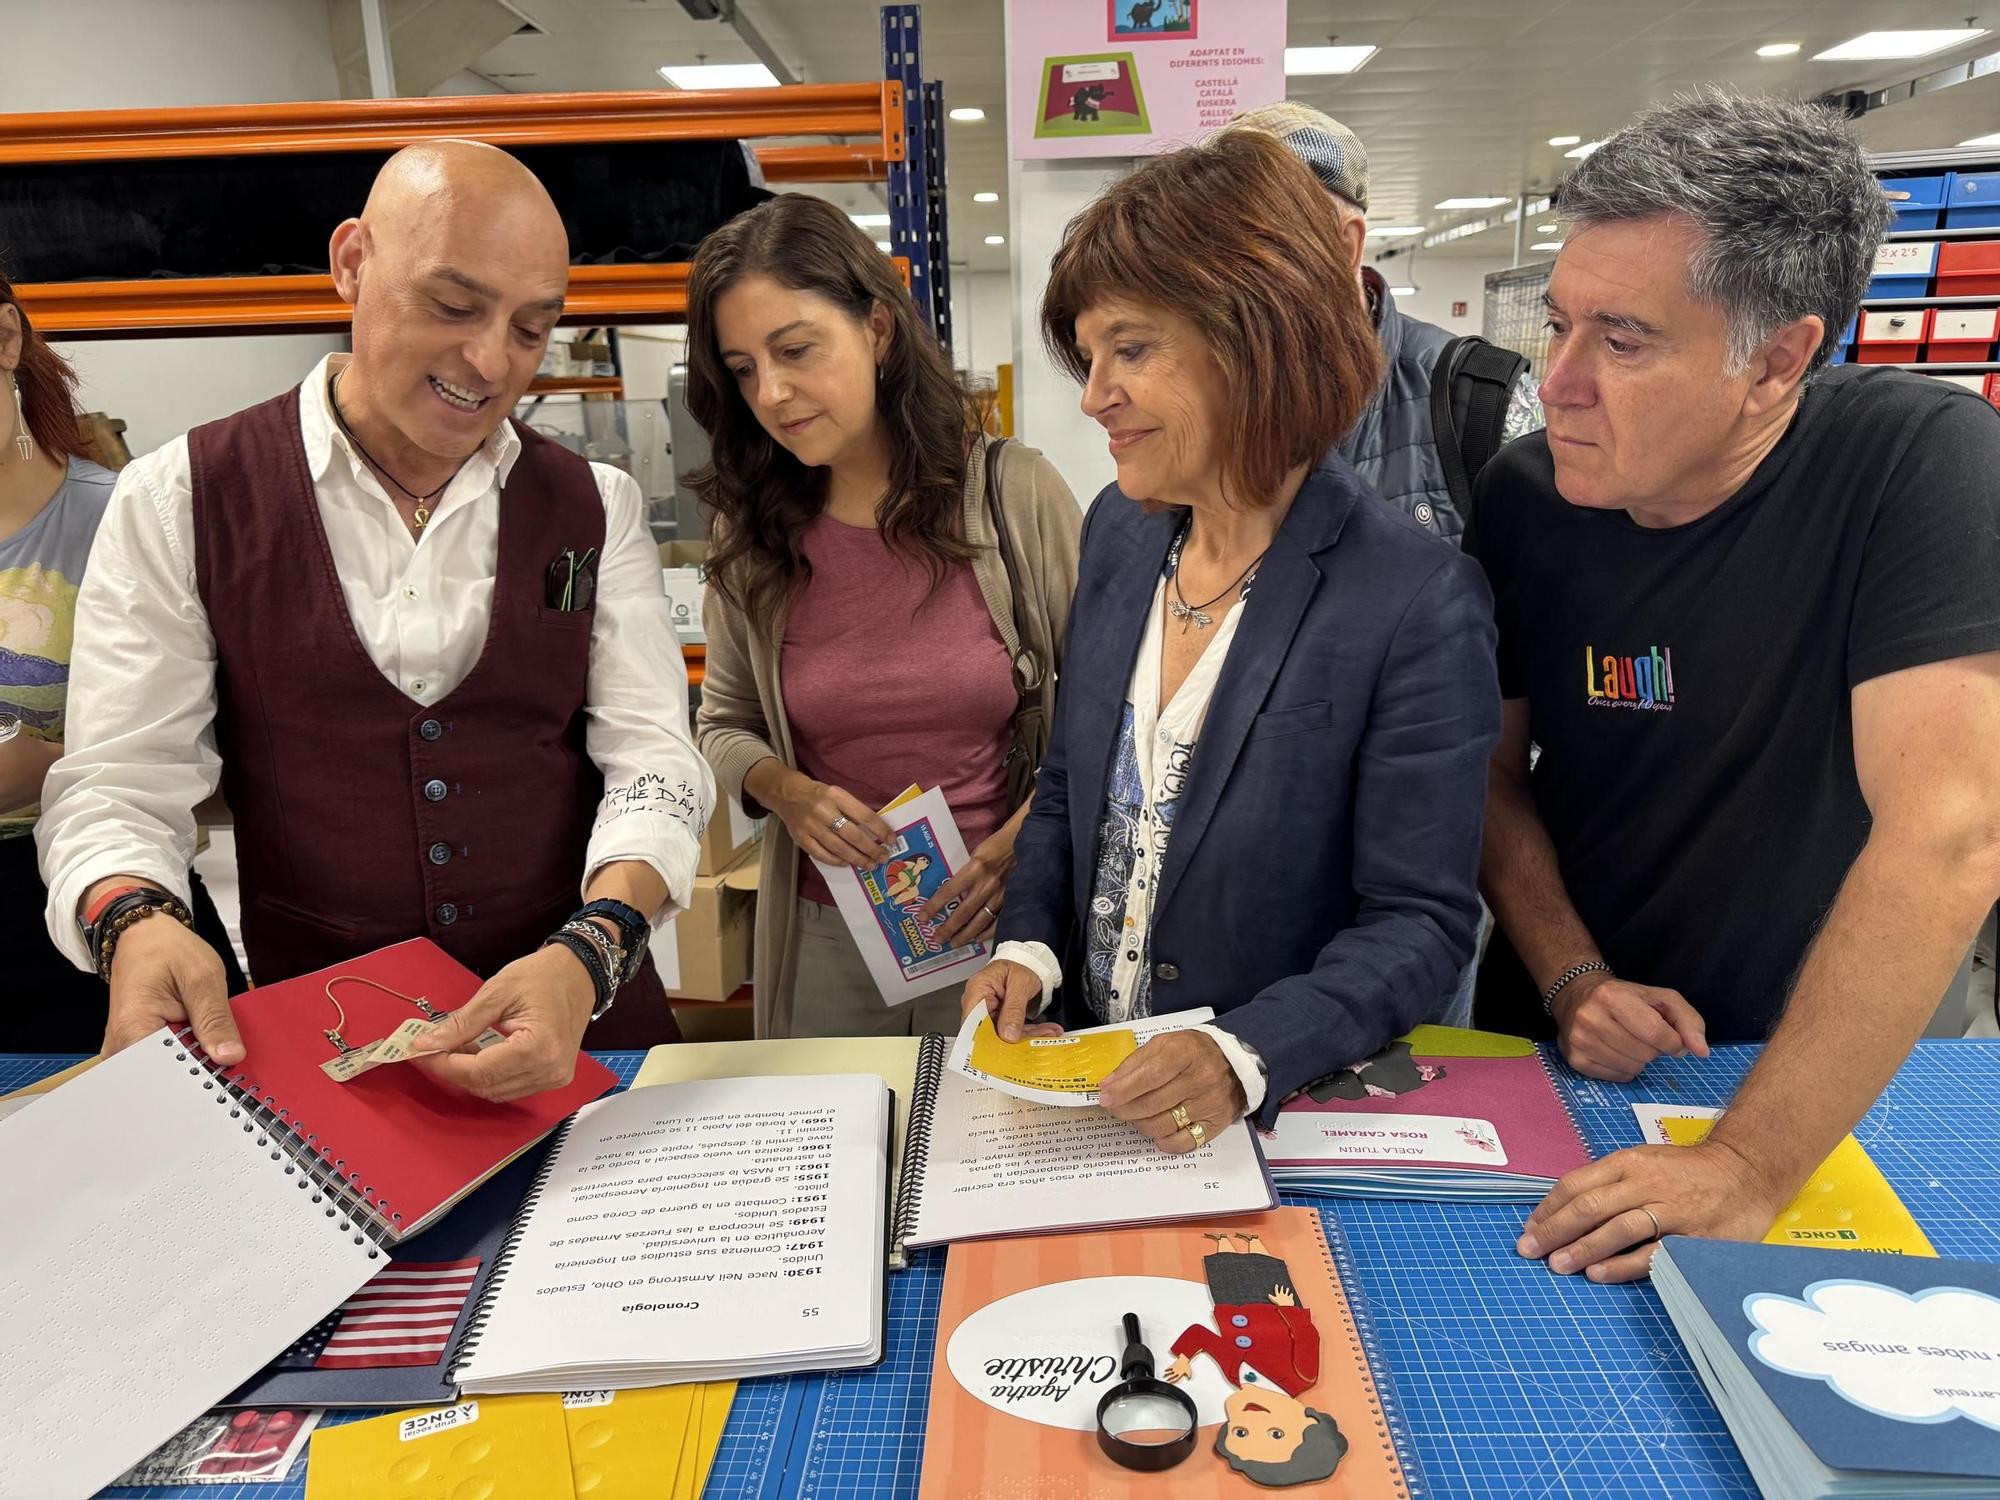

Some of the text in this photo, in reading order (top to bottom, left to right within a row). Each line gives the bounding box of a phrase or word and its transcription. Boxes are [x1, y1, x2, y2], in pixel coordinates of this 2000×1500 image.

[1189, 47, 1245, 57] ADAPTAT EN
[1169, 59, 1220, 68] DIFERENTS
[1196, 99, 1236, 107] EUSKERA
[1200, 109, 1233, 117] GALLEG
[1586, 646, 1675, 705] Laugh!
[866, 880, 882, 902] ONCE
[697, 1113, 724, 1121] pisar
[788, 1108, 822, 1116] primer
[652, 1118, 681, 1126] Luna.
[702, 1123, 732, 1131] Apolo
[616, 1128, 665, 1140] convierte
[1320, 1130, 1386, 1138] CARAMEL
[698, 1141, 746, 1150] después,
[766, 1136, 803, 1145] Gemini
[638, 1147, 658, 1155] con
[661, 1144, 693, 1152] repite
[1339, 1145, 1424, 1155] ADELA TURIN
[595, 1152, 621, 1161] nave
[655, 1153, 699, 1163] espacial
[752, 1154, 814, 1163] astronauta.
[969, 1149, 1141, 1172] soledad, fuerza ganas
[1142, 1155, 1178, 1164] diario.
[608, 1159, 640, 1168] bordo
[1084, 1160, 1123, 1169] hacerlo
[667, 1171, 724, 1180] selecciona
[743, 1167, 773, 1175] NASA
[1006, 1164, 1078, 1177] desaparecían
[1096, 1166, 1152, 1177] agradable
[732, 1176, 771, 1186] gradúa
[794, 1173, 829, 1181] 1955:
[571, 1180, 634, 1192] convertirse
[652, 1182, 708, 1193] Ingeniería
[795, 1182, 828, 1191] piloto.
[953, 1183, 994, 1193] escribir
[572, 1188, 648, 1202] Aeroespacial.
[792, 1194, 827, 1202] 1951:
[735, 1198, 786, 1206] Combate
[660, 1203, 698, 1212] guerra
[734, 1205, 826, 1218] Estados Unidos.
[567, 1214, 598, 1223] como
[789, 1216, 825, 1226] 1949:
[709, 1222, 764, 1230] incorpora
[626, 1229, 672, 1238] Fuerzas
[754, 1228, 825, 1240] Aeronáutica
[1791, 1231, 1837, 1239] ONCE
[568, 1234, 622, 1244] Armadas
[643, 1237, 715, 1249] universidad.
[722, 1245, 780, 1254] Comienza
[786, 1241, 824, 1251] 1947:
[641, 1250, 692, 1260] estudios
[778, 1254, 823, 1264] Unidos.
[555, 1256, 617, 1270] Ingeniería
[784, 1266, 822, 1277] 1930:
[648, 1274, 715, 1284] Armstrong
[719, 1273, 742, 1281] Neil
[536, 1284, 585, 1295] Estados
[592, 1281, 623, 1289] Ohio,
[622, 1302, 699, 1314] Cronología
[802, 1307, 819, 1317] 55
[1822, 1340, 1992, 1361] nubes amigas
[983, 1355, 1117, 1384] Christie
[989, 1377, 1071, 1404] Agatha
[404, 1409, 456, 1431] ONCE
[404, 1418, 457, 1438] grup social
